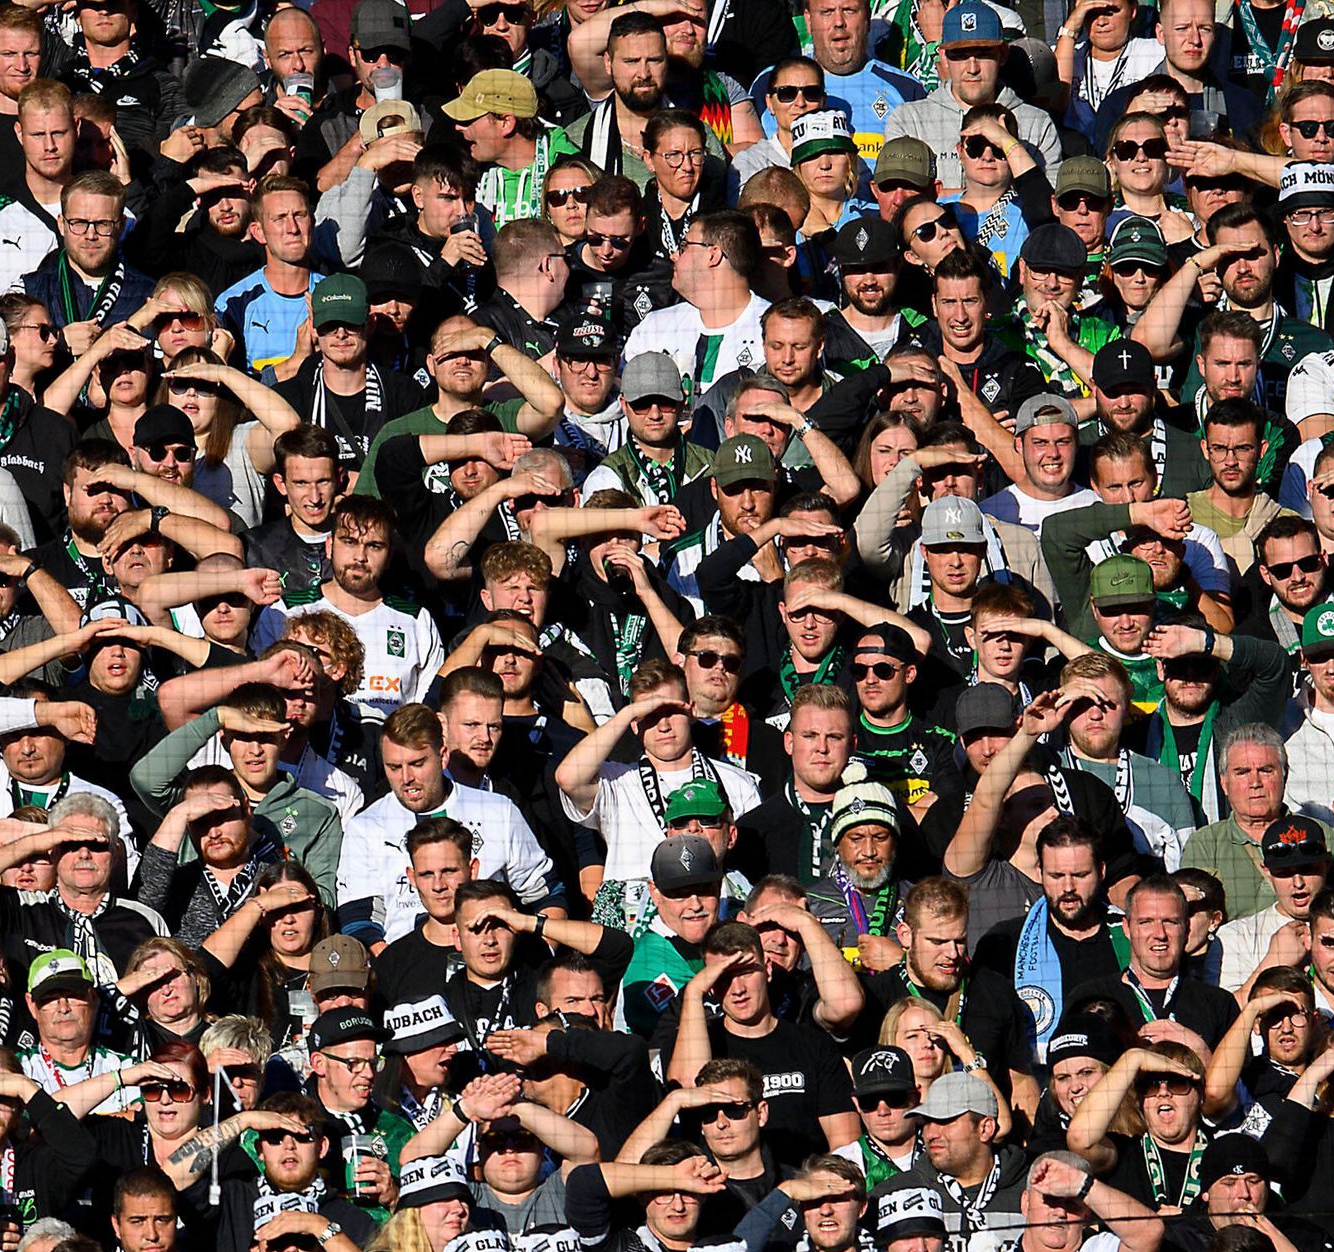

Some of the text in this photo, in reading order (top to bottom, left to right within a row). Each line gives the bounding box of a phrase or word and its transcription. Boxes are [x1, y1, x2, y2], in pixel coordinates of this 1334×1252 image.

[0, 453, 45, 475] gladbach
[944, 506, 962, 525] NY
[762, 1072, 805, 1091] 1900
